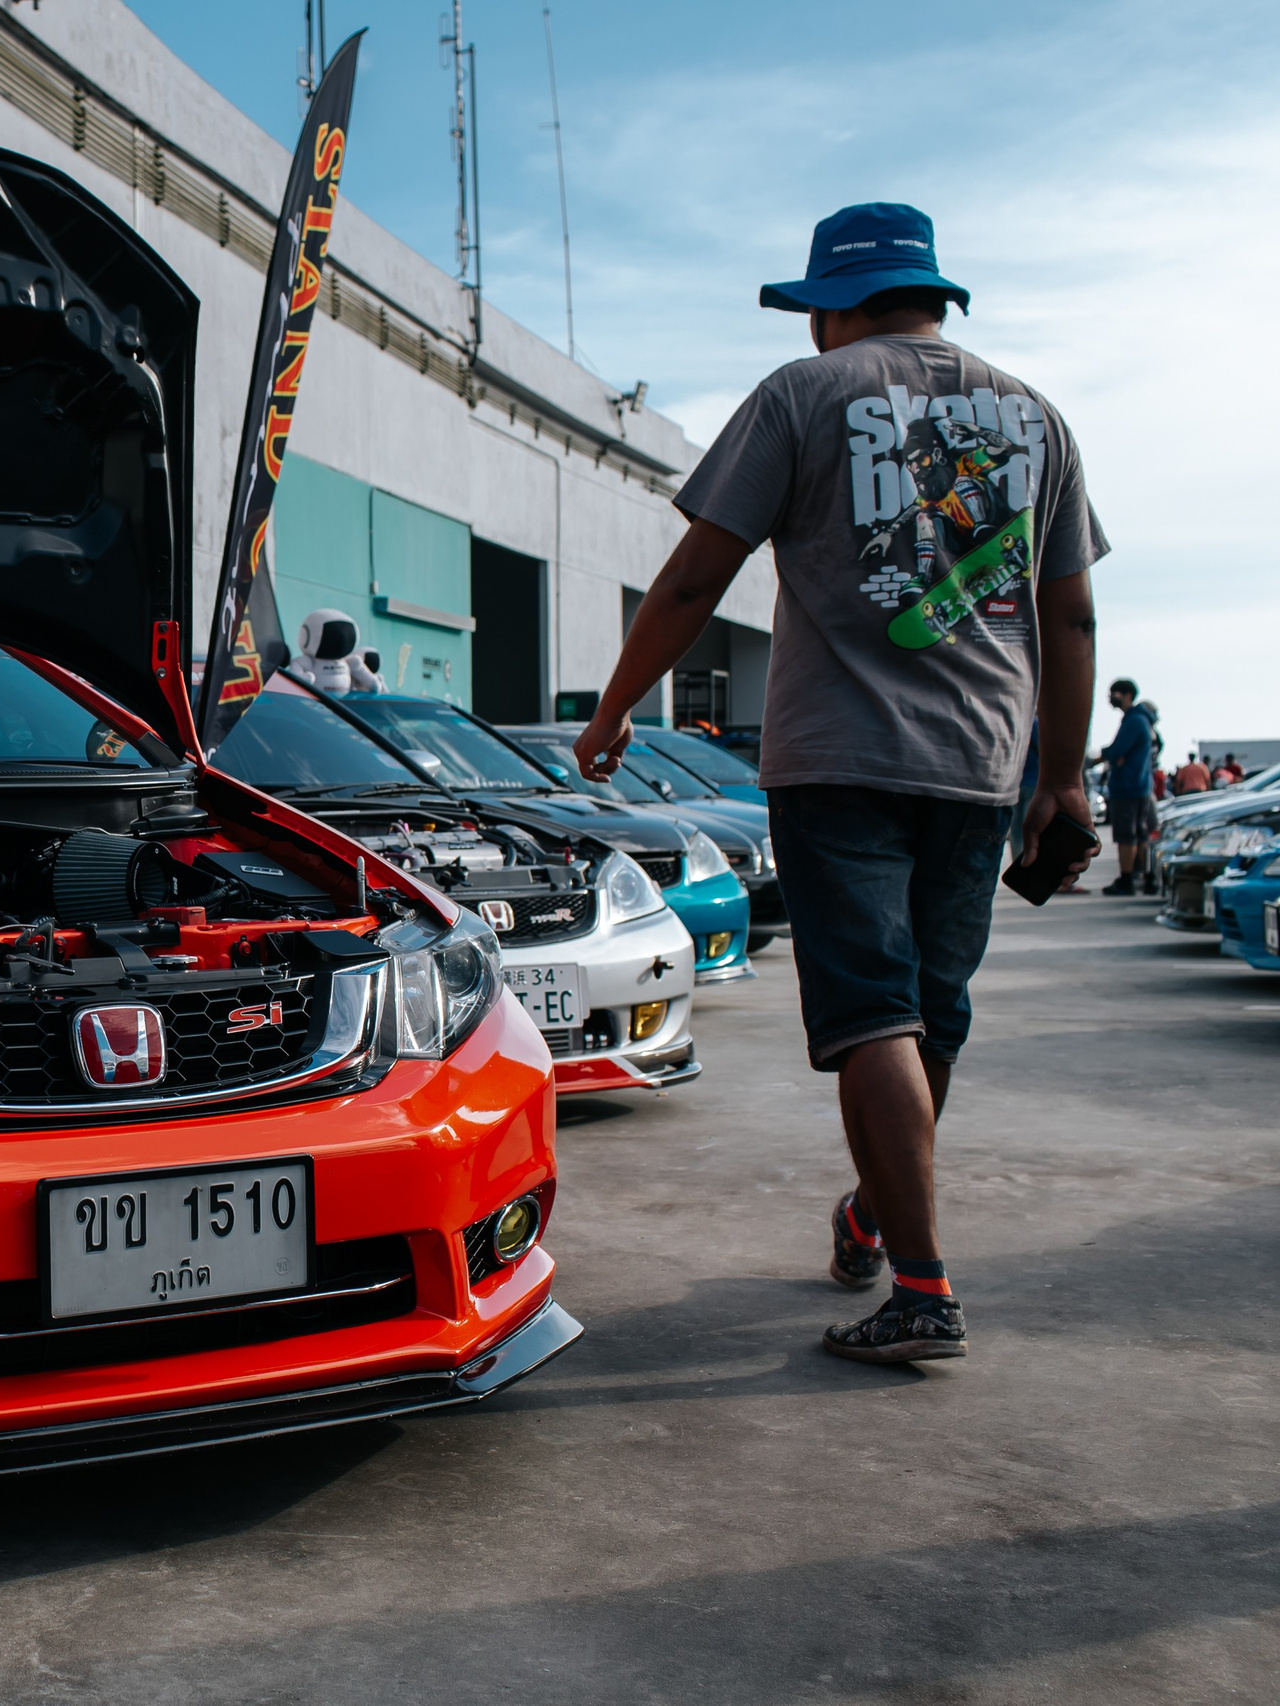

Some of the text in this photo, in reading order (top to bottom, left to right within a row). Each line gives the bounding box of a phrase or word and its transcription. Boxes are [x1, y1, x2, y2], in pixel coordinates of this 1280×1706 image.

[264, 122, 346, 484] STAND
[846, 384, 1045, 456] skate
[531, 967, 556, 986] 34
[227, 1000, 283, 1034] Si
[75, 1177, 296, 1252] ขข 1510
[150, 1257, 211, 1300] ภูเก็ต
